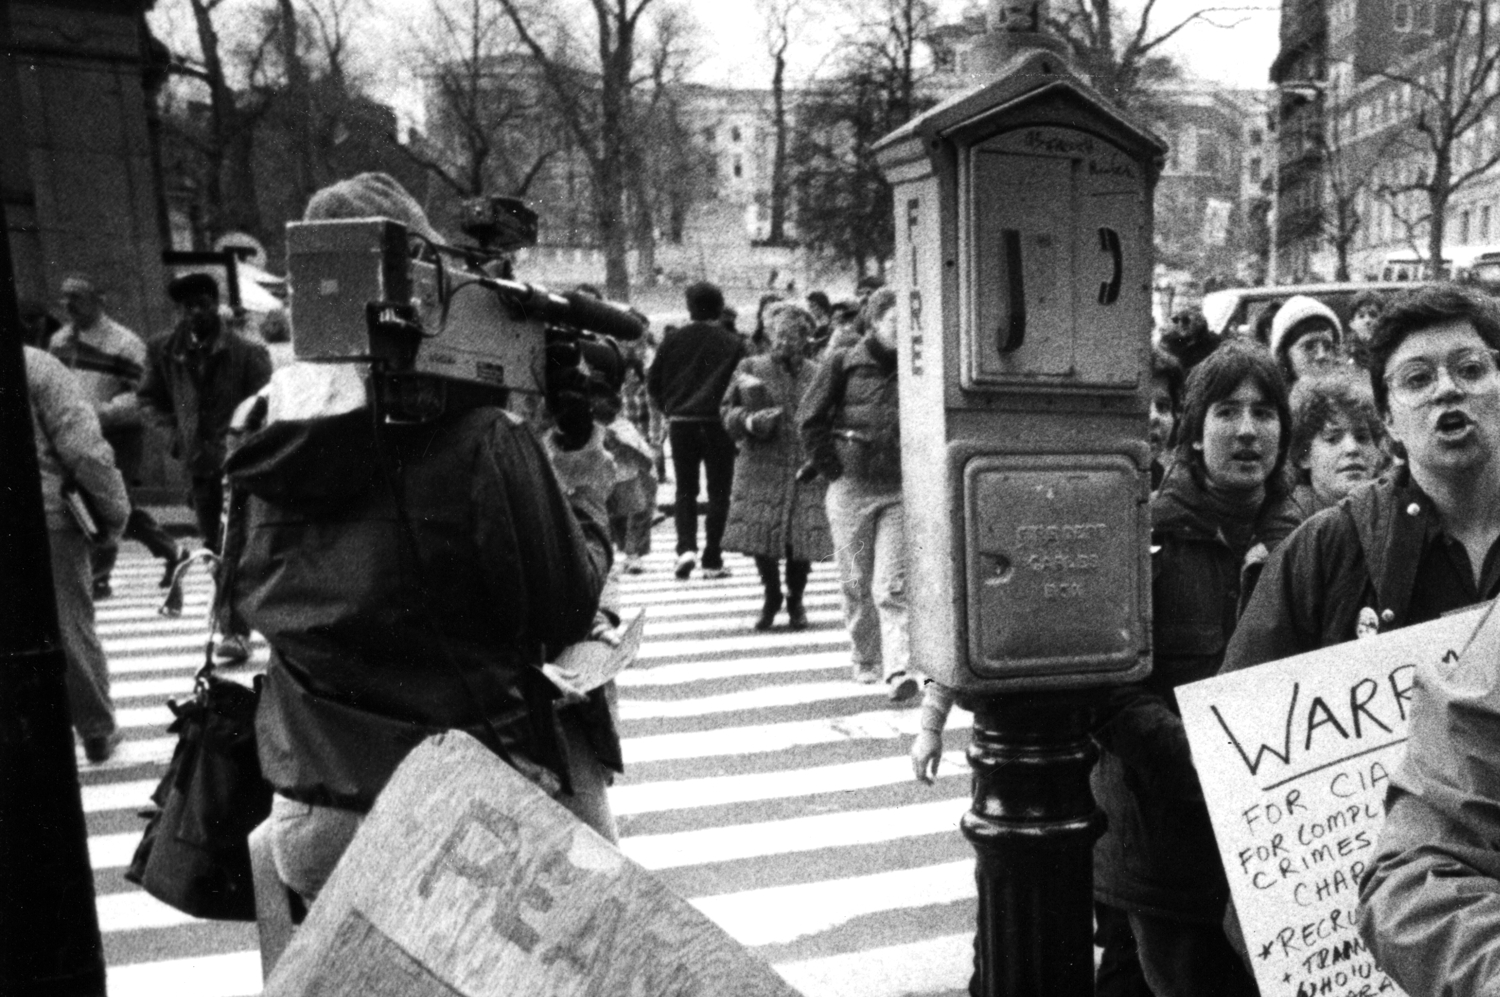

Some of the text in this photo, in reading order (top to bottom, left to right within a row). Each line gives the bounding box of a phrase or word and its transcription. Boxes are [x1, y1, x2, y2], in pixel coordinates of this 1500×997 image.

[908, 198, 924, 377] FIRE
[1241, 762, 1390, 834] FOR CIA
[1238, 833, 1290, 875] FOR
[1251, 831, 1373, 890] CRIMES
